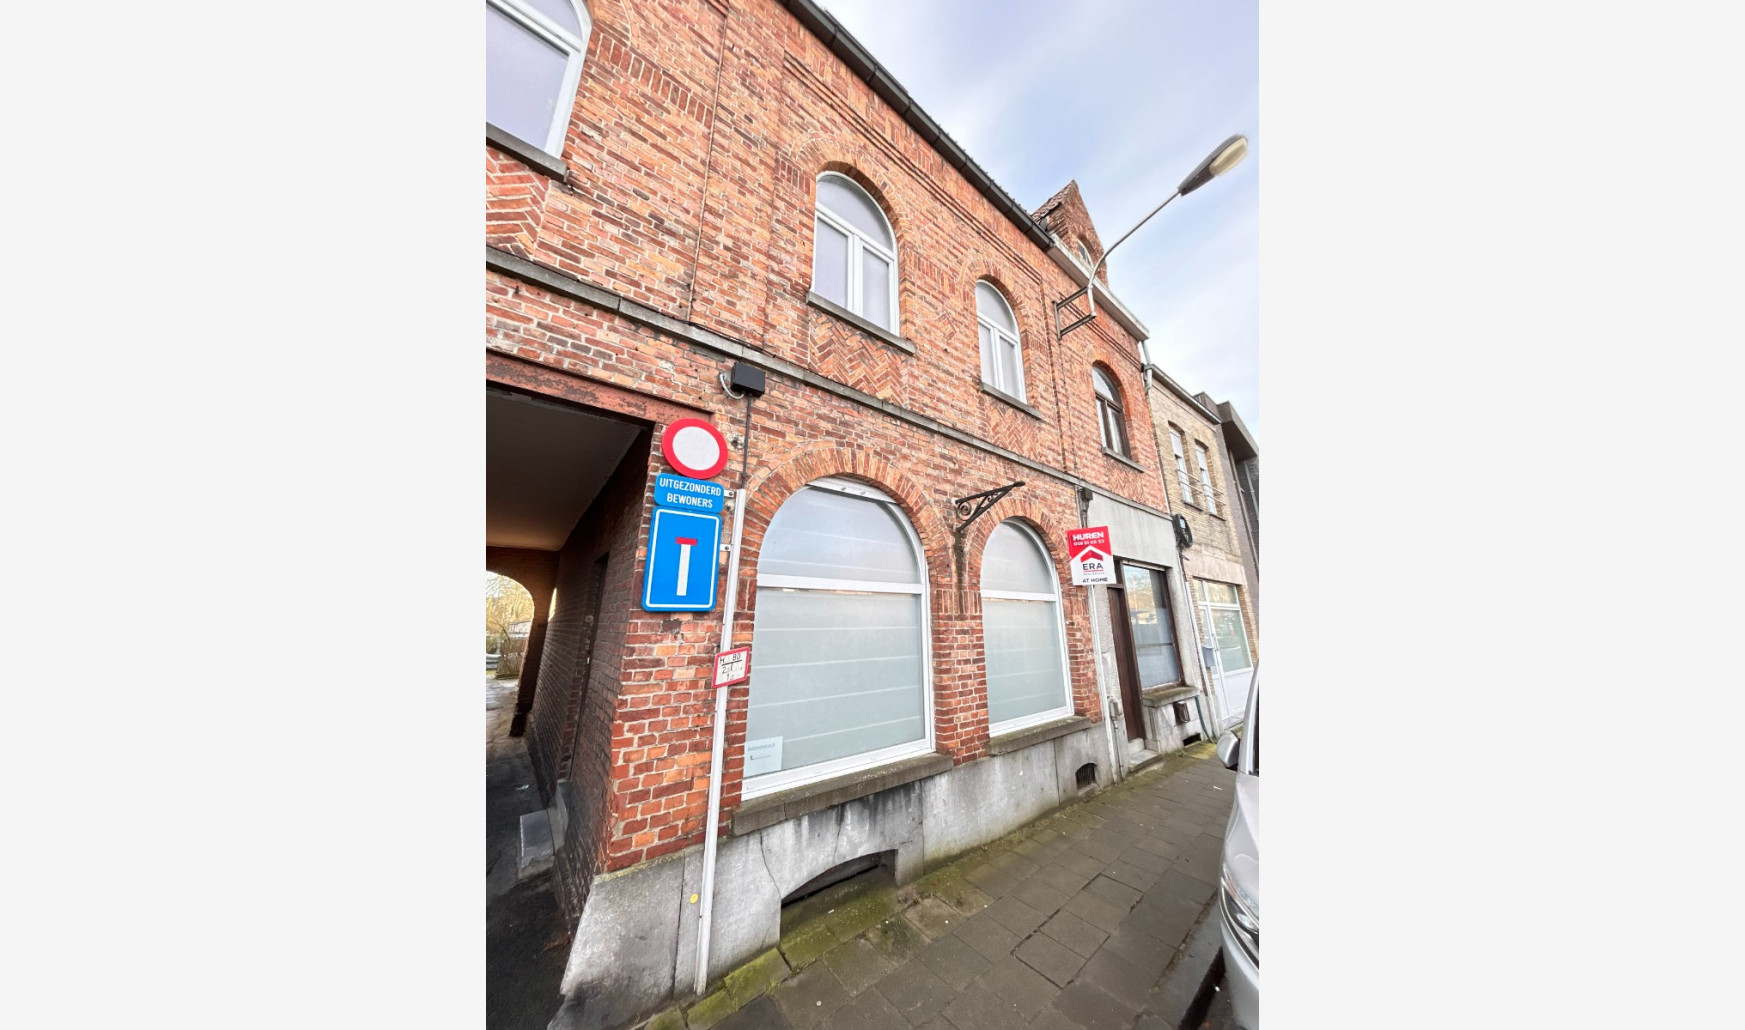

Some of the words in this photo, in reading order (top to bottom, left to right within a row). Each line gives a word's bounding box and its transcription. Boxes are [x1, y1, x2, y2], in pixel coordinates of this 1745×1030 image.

[659, 477, 721, 496] UITGEZONDERD
[667, 492, 713, 508] BEWONERS
[1073, 532, 1104, 541] HUREN
[1082, 562, 1103, 570] ERA
